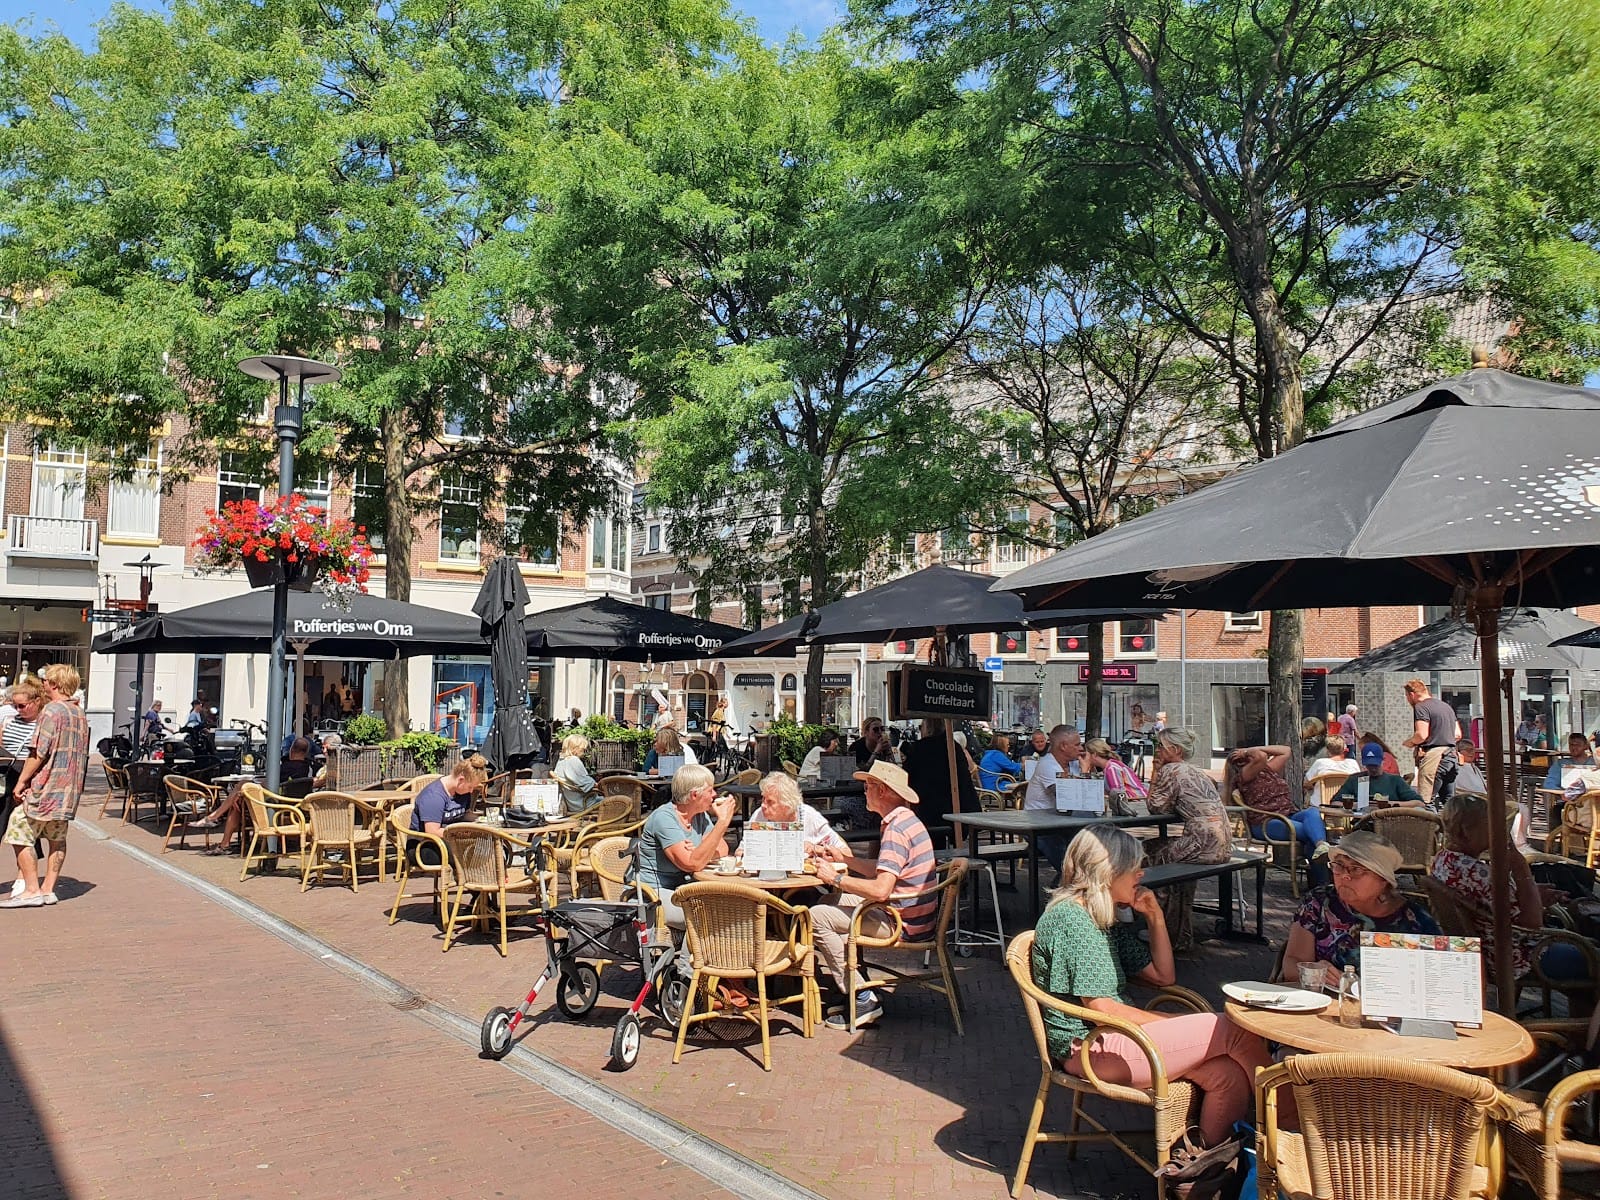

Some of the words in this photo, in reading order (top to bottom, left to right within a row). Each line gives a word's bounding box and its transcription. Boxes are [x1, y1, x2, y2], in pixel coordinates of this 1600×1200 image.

[293, 619, 355, 635] Poffertjes
[356, 622, 373, 631] VAN
[373, 620, 414, 636] Oma
[638, 632, 682, 647] Poffertjes
[694, 634, 723, 648] Oma
[925, 678, 975, 694] Chocolade
[924, 693, 976, 709] truffeltaart
